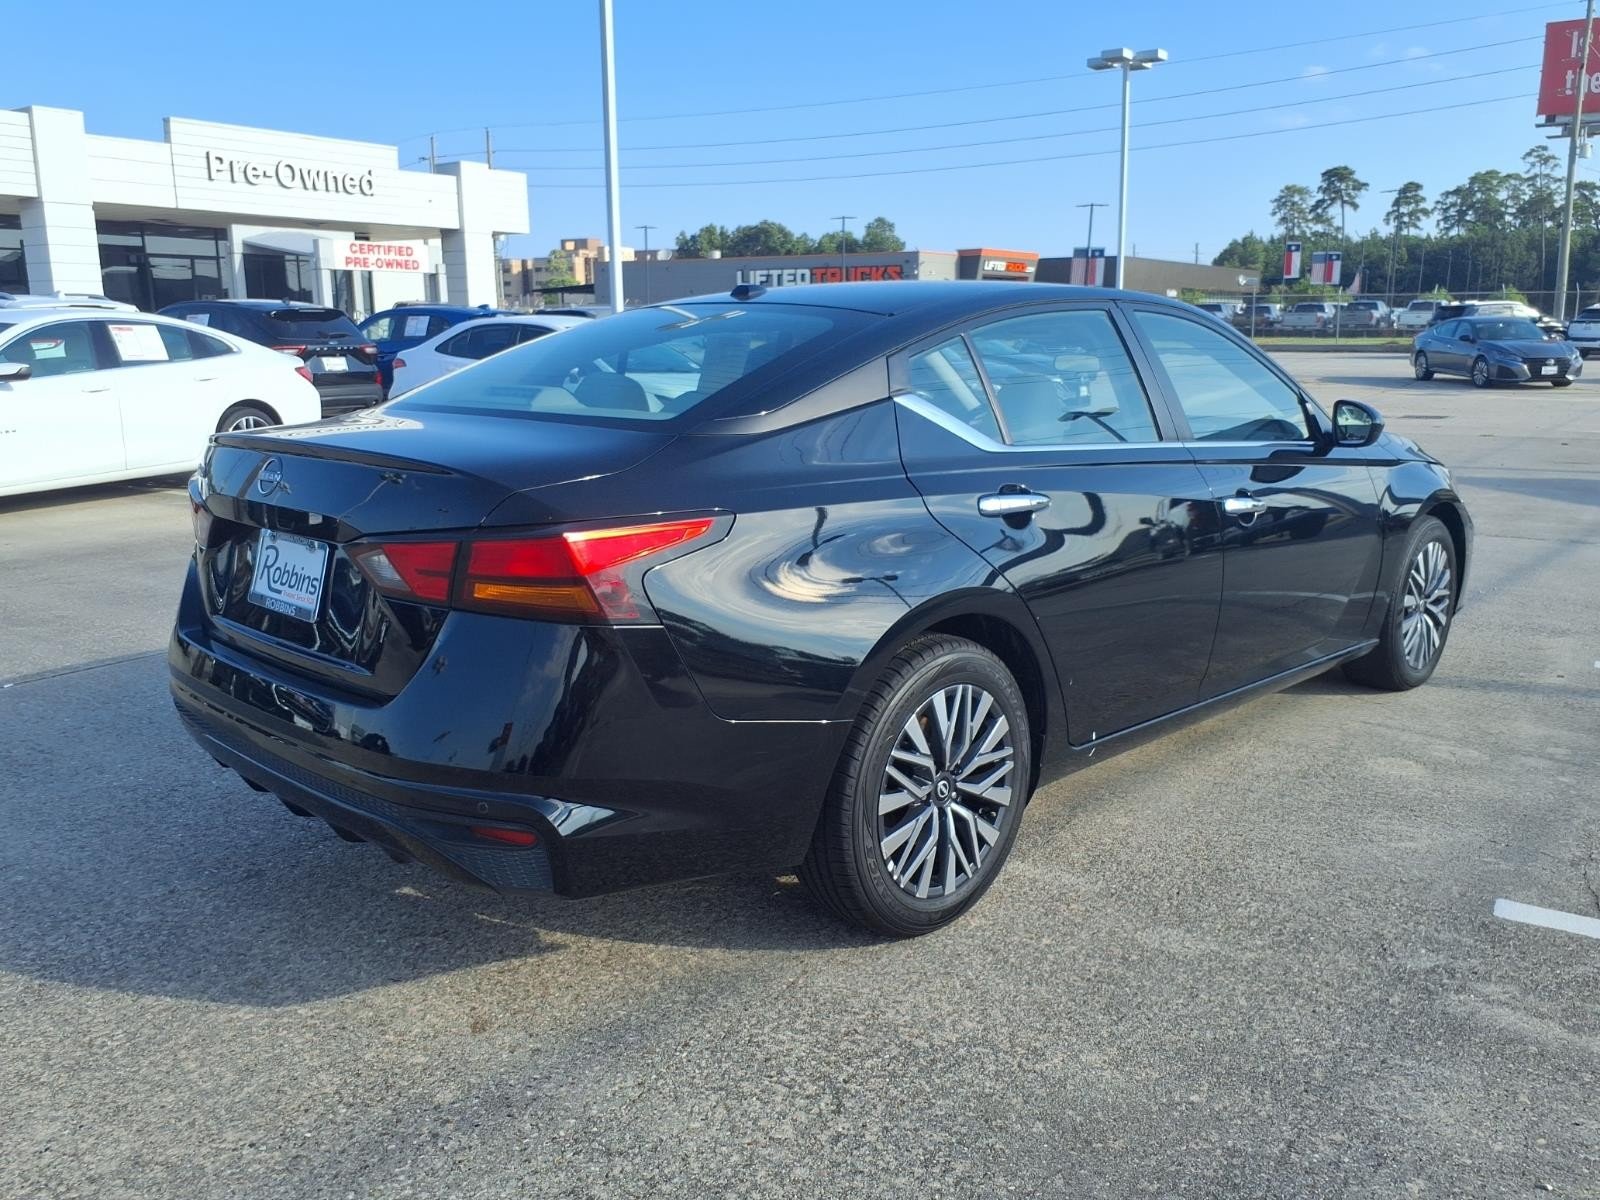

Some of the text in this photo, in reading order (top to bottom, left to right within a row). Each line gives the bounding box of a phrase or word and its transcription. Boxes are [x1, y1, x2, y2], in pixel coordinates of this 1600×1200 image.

[206, 150, 374, 196] Pre-Owned
[345, 256, 420, 271] PRE-OWNED
[349, 242, 414, 257] CERTIFIED
[260, 545, 319, 595] Robbins
